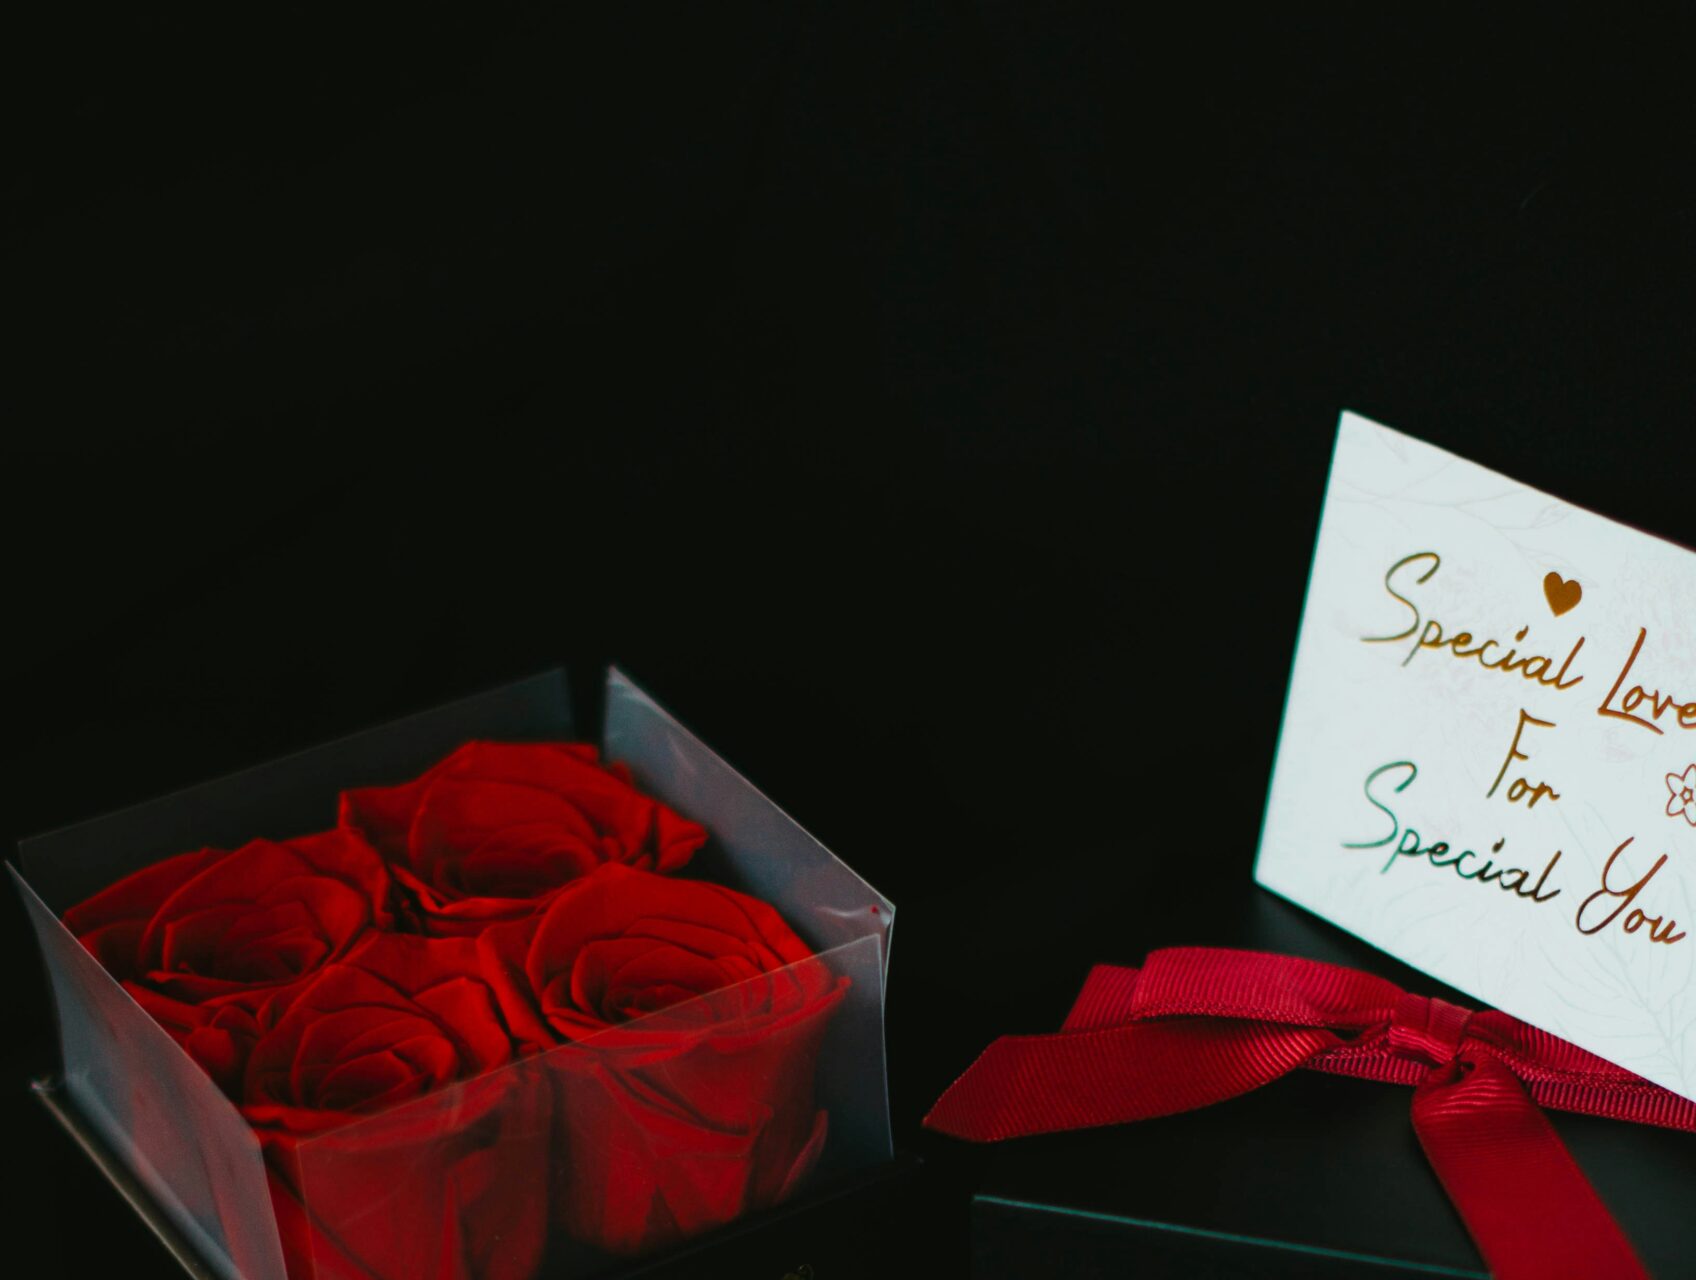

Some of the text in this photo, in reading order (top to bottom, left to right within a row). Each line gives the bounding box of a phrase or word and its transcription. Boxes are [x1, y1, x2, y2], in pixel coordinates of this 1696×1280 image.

[1359, 552, 1696, 735] Special Love
[1486, 708, 1561, 809] For
[1341, 760, 1688, 945] Special You
